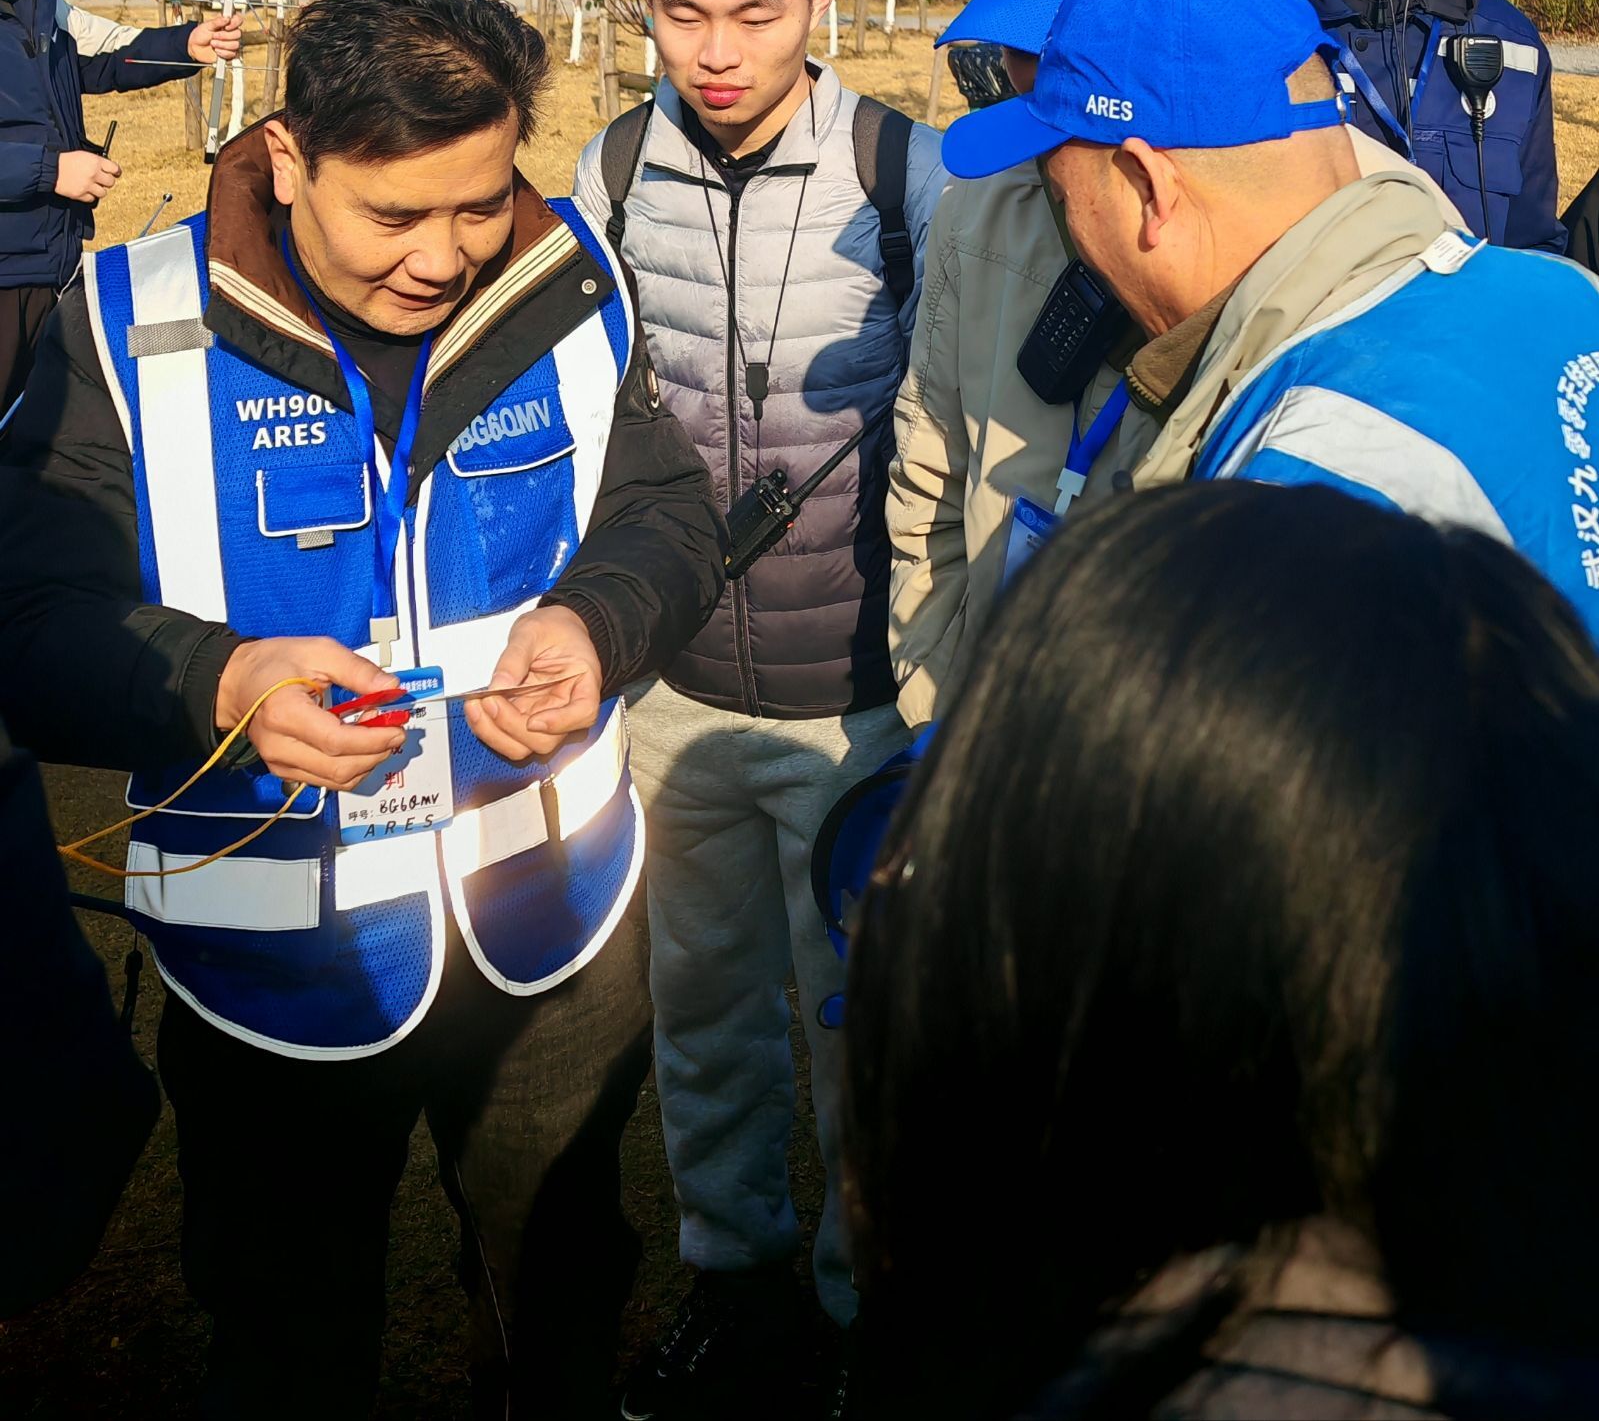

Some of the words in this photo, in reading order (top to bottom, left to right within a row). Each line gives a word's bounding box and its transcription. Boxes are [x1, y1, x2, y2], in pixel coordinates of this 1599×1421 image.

[1085, 93, 1133, 122] ARES
[252, 421, 327, 450] ARES
[448, 397, 551, 454] BG6QMV
